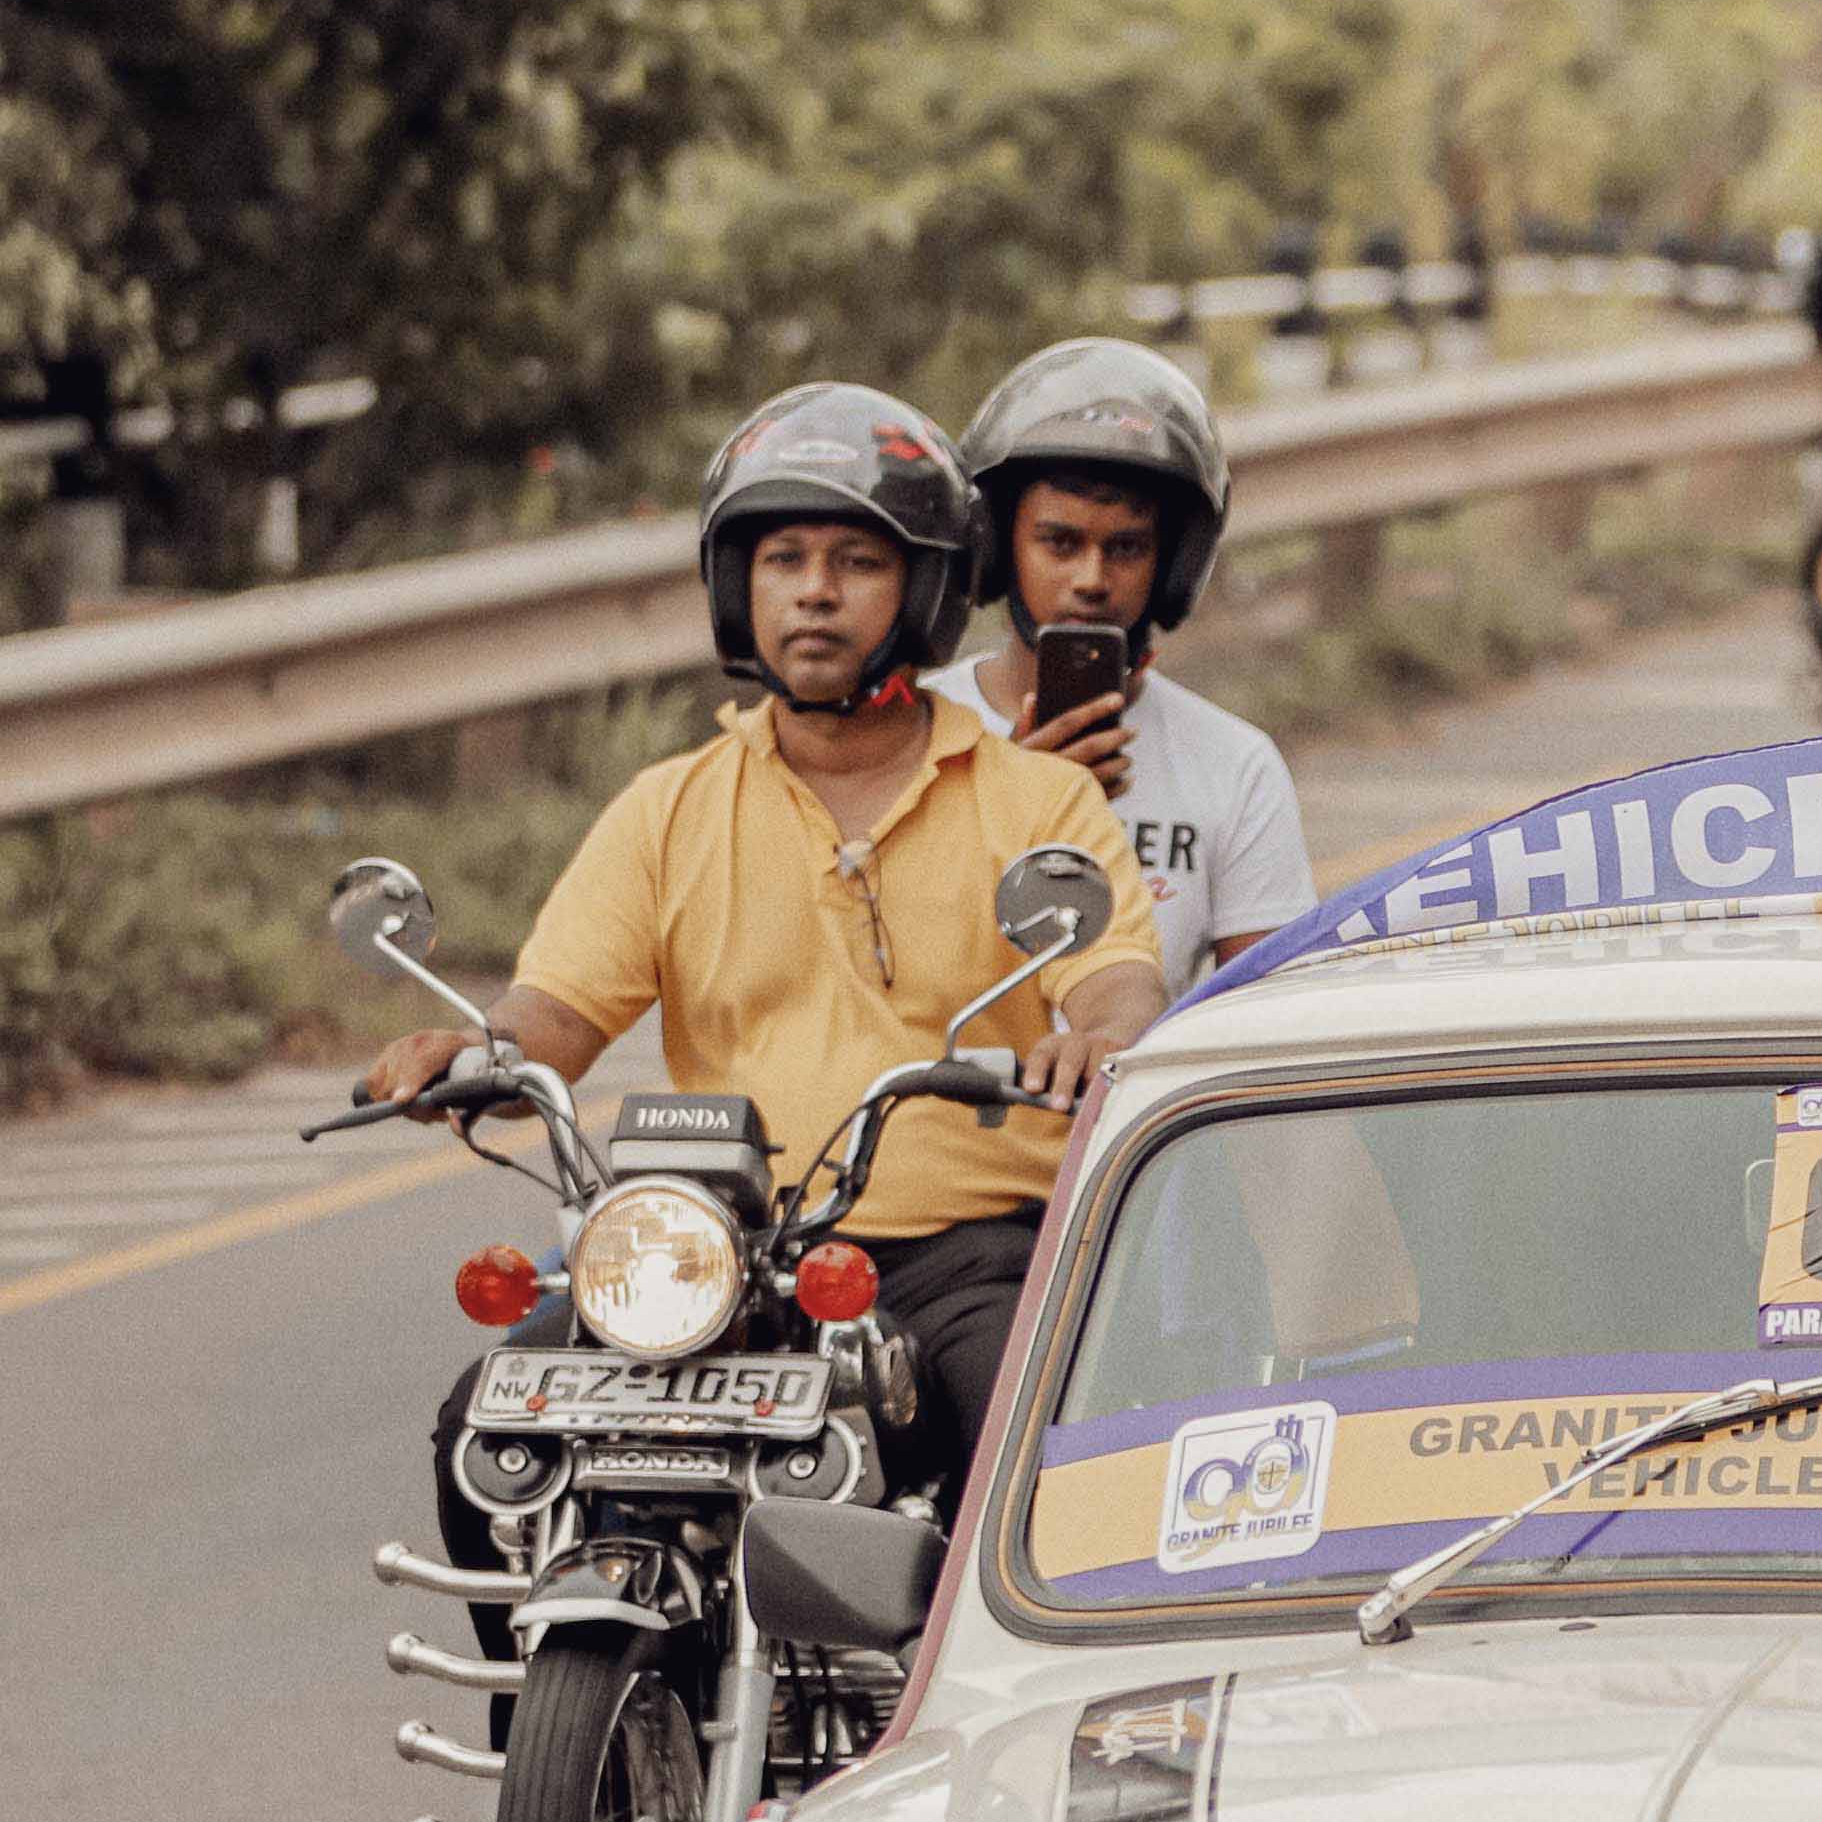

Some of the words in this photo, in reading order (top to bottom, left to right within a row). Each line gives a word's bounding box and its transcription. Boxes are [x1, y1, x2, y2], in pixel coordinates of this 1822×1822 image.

[1122, 821, 1197, 871] ER
[635, 1105, 732, 1132] HONDA
[492, 1380, 531, 1400] NW
[1409, 1404, 1706, 1458] GRANIT
[592, 1450, 724, 1471] HONDA
